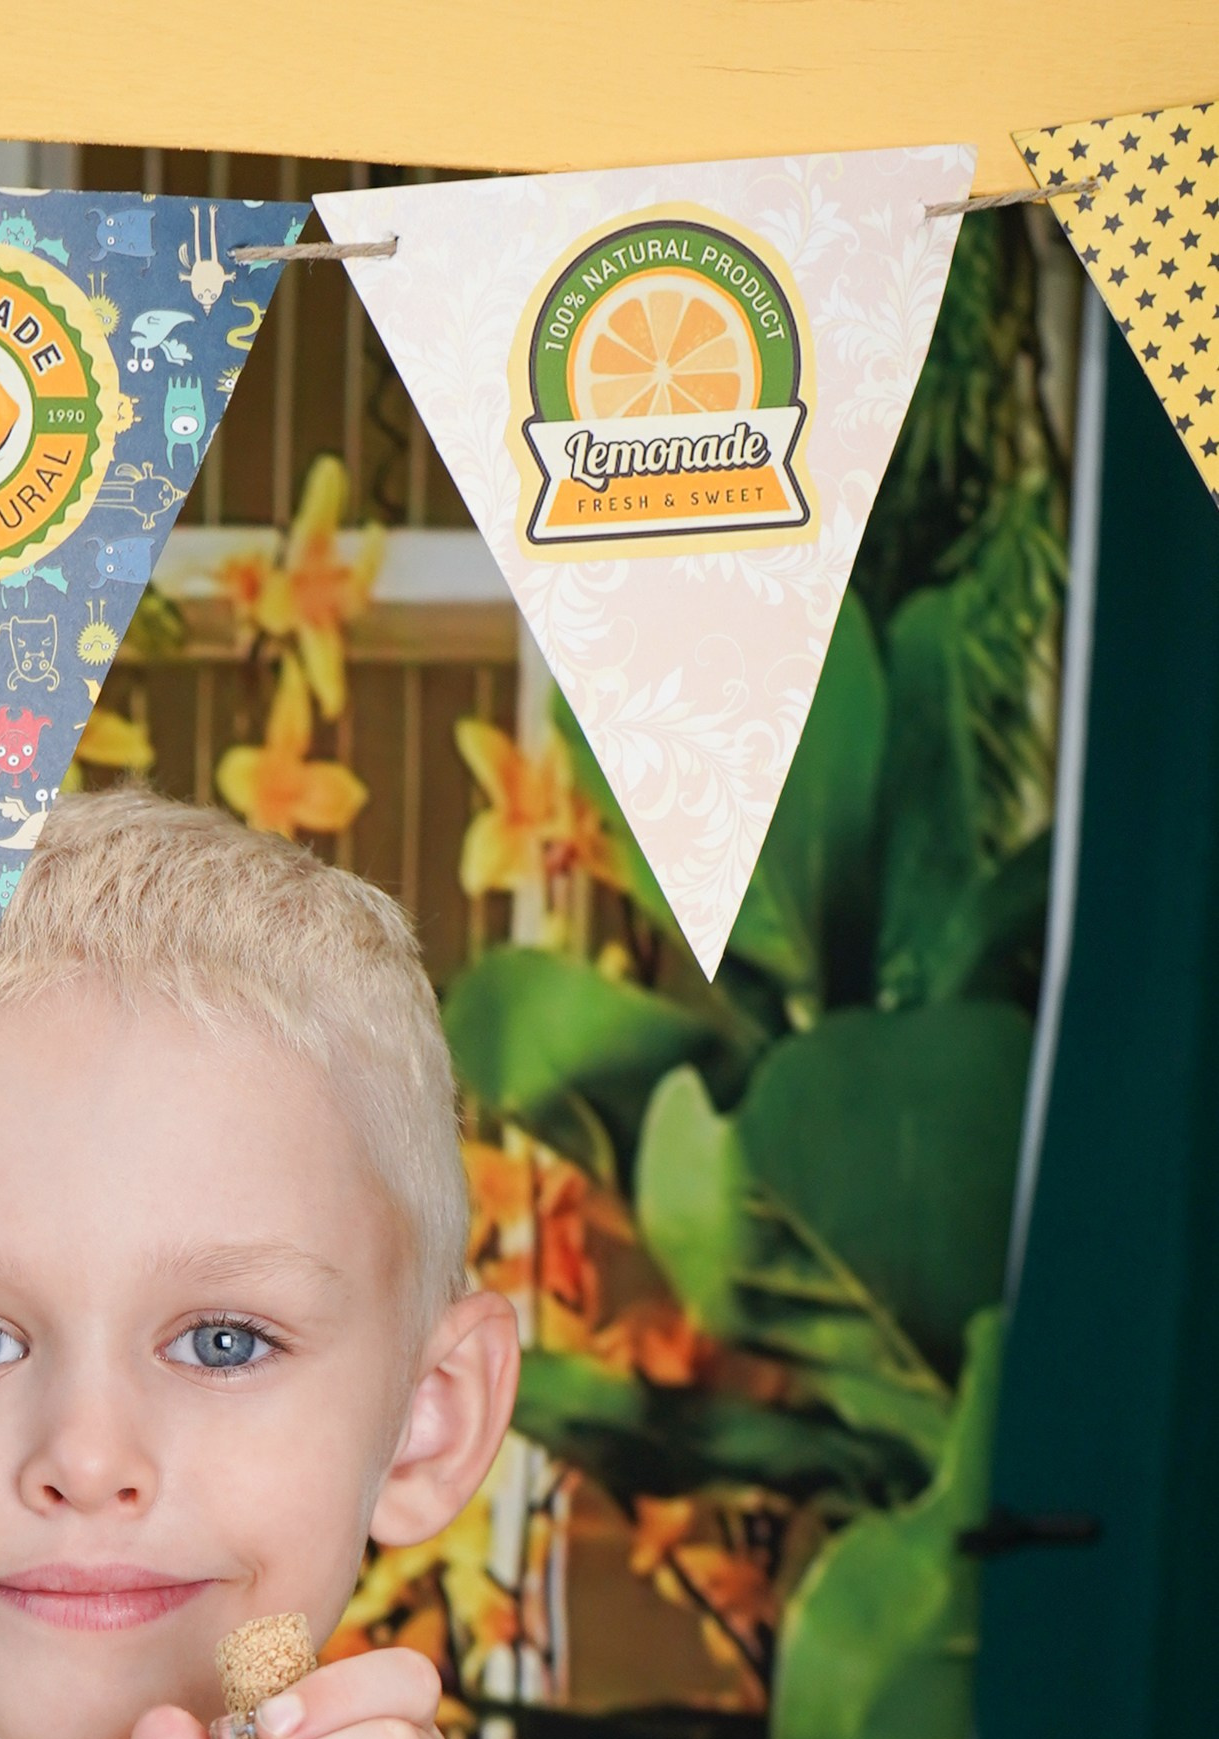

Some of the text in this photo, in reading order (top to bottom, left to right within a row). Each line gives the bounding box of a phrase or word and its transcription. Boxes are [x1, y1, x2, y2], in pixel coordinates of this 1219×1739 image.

[545, 238, 786, 352] 100% NATURAL PRODUCT
[47, 409, 86, 425] 1990
[565, 422, 772, 493] Lemonade
[577, 486, 766, 514] FRESH & SWEET
